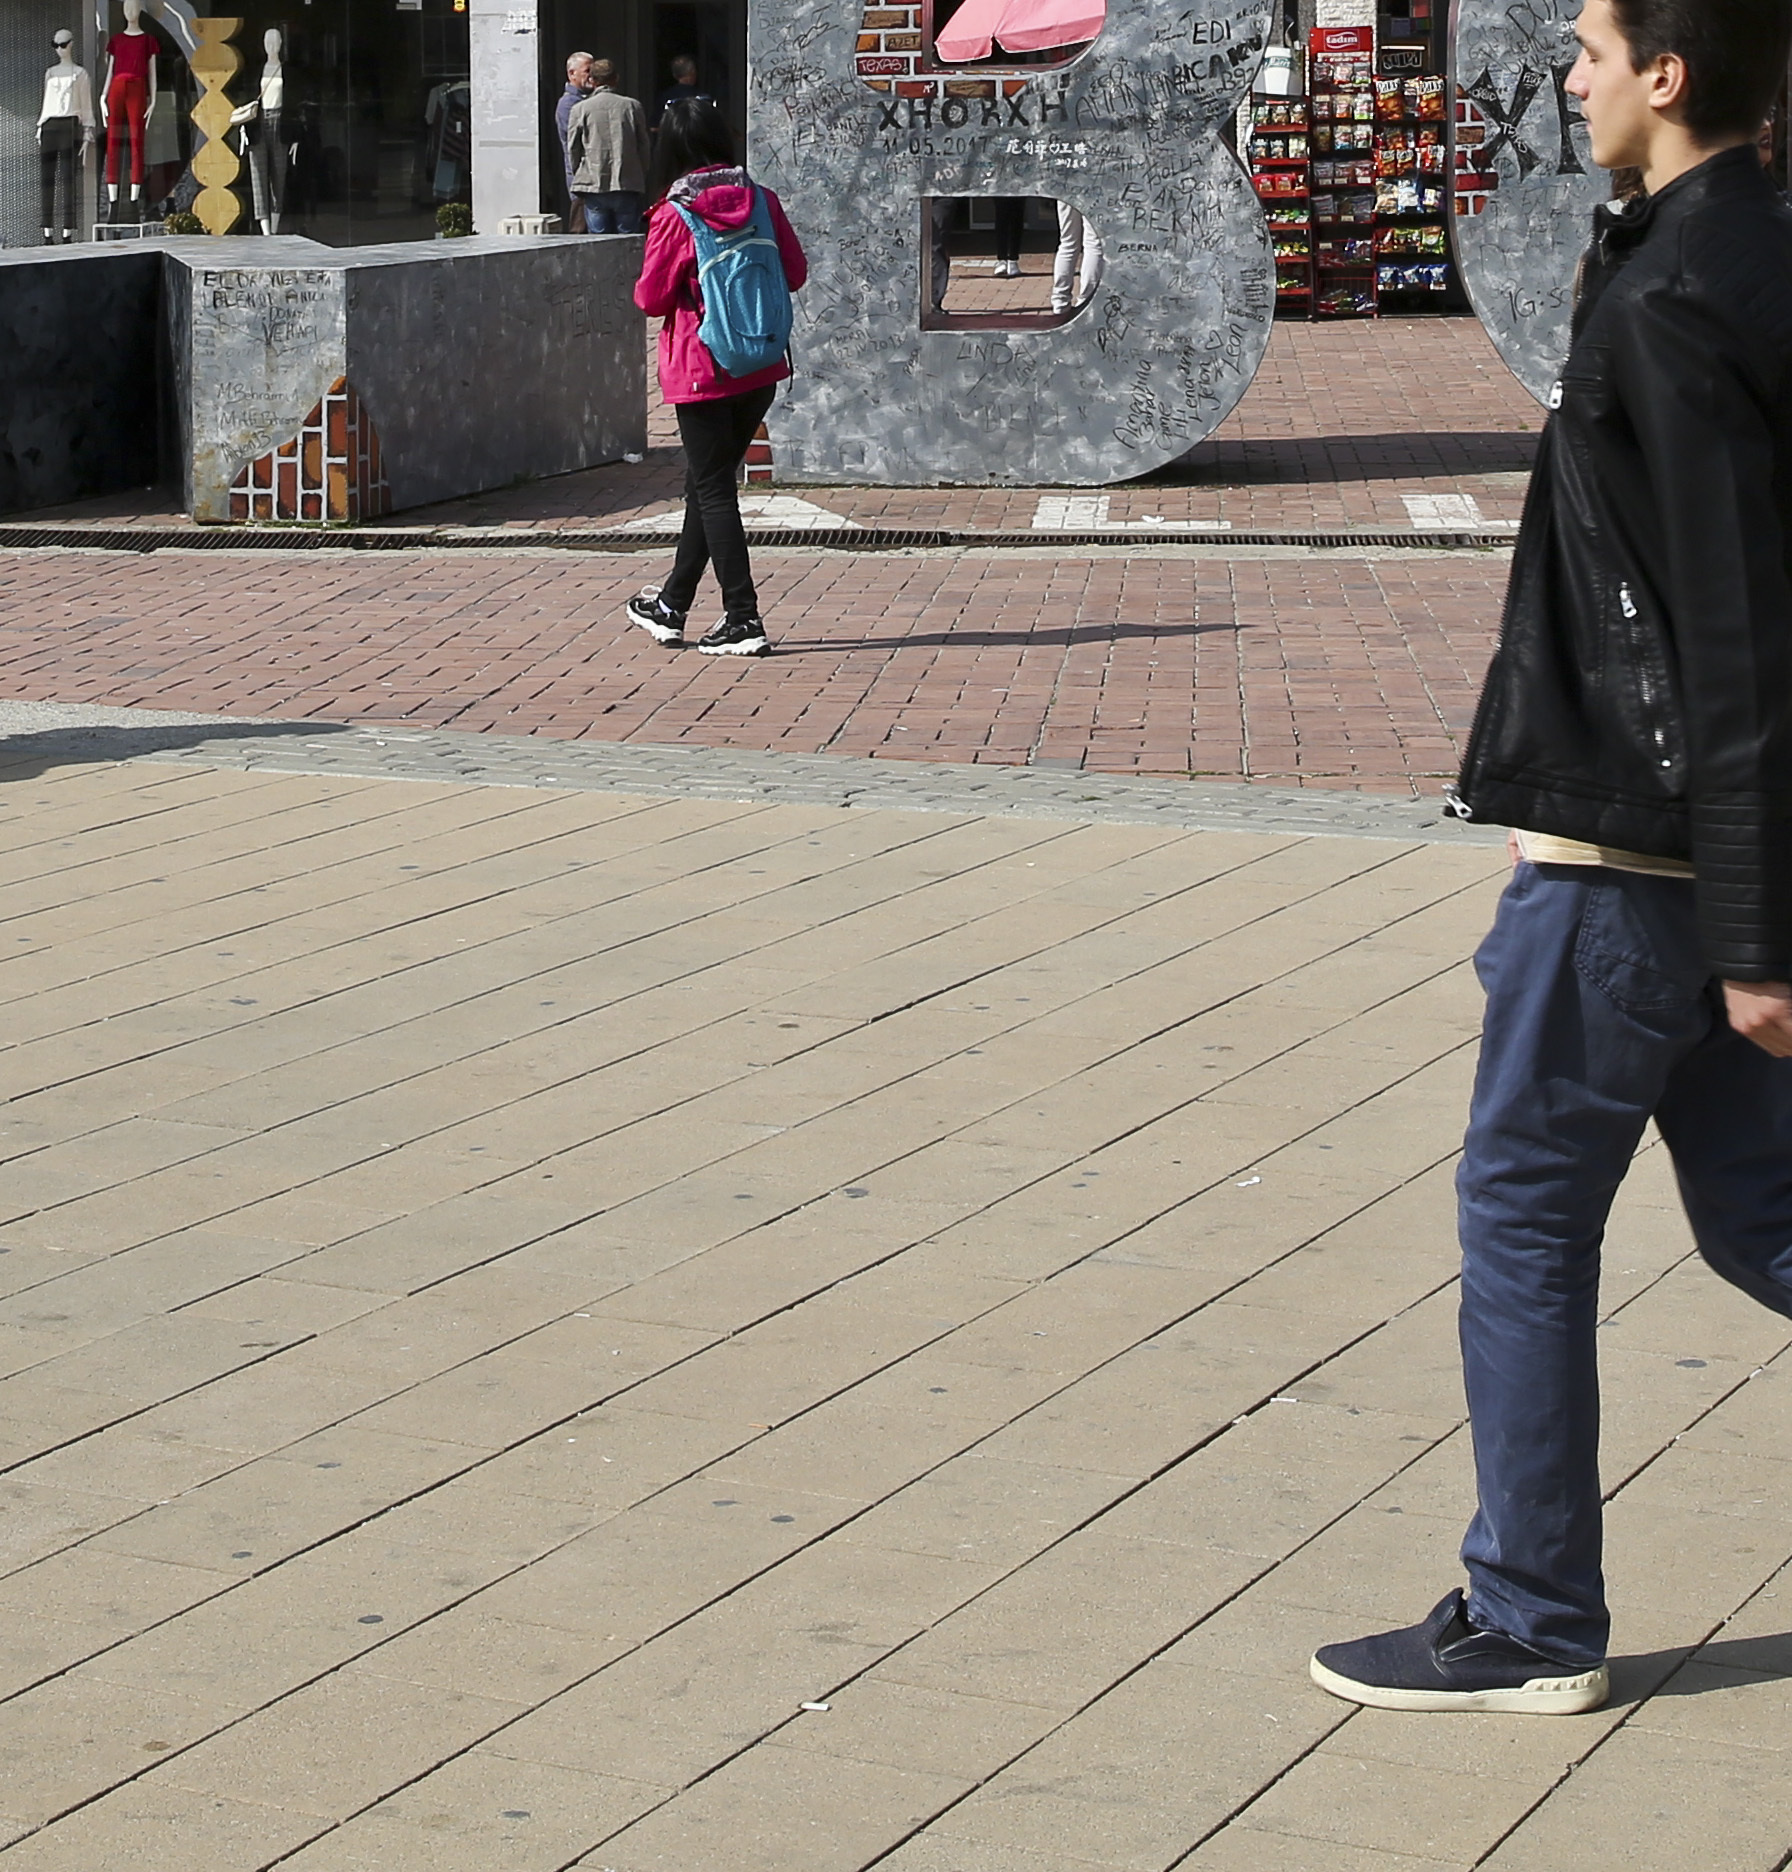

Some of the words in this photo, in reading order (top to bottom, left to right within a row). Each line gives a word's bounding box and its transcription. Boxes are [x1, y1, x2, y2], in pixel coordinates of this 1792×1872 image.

[1192, 19, 1232, 45] EDI
[887, 35, 918, 47] AZET
[1118, 243, 1158, 254] BERNA
